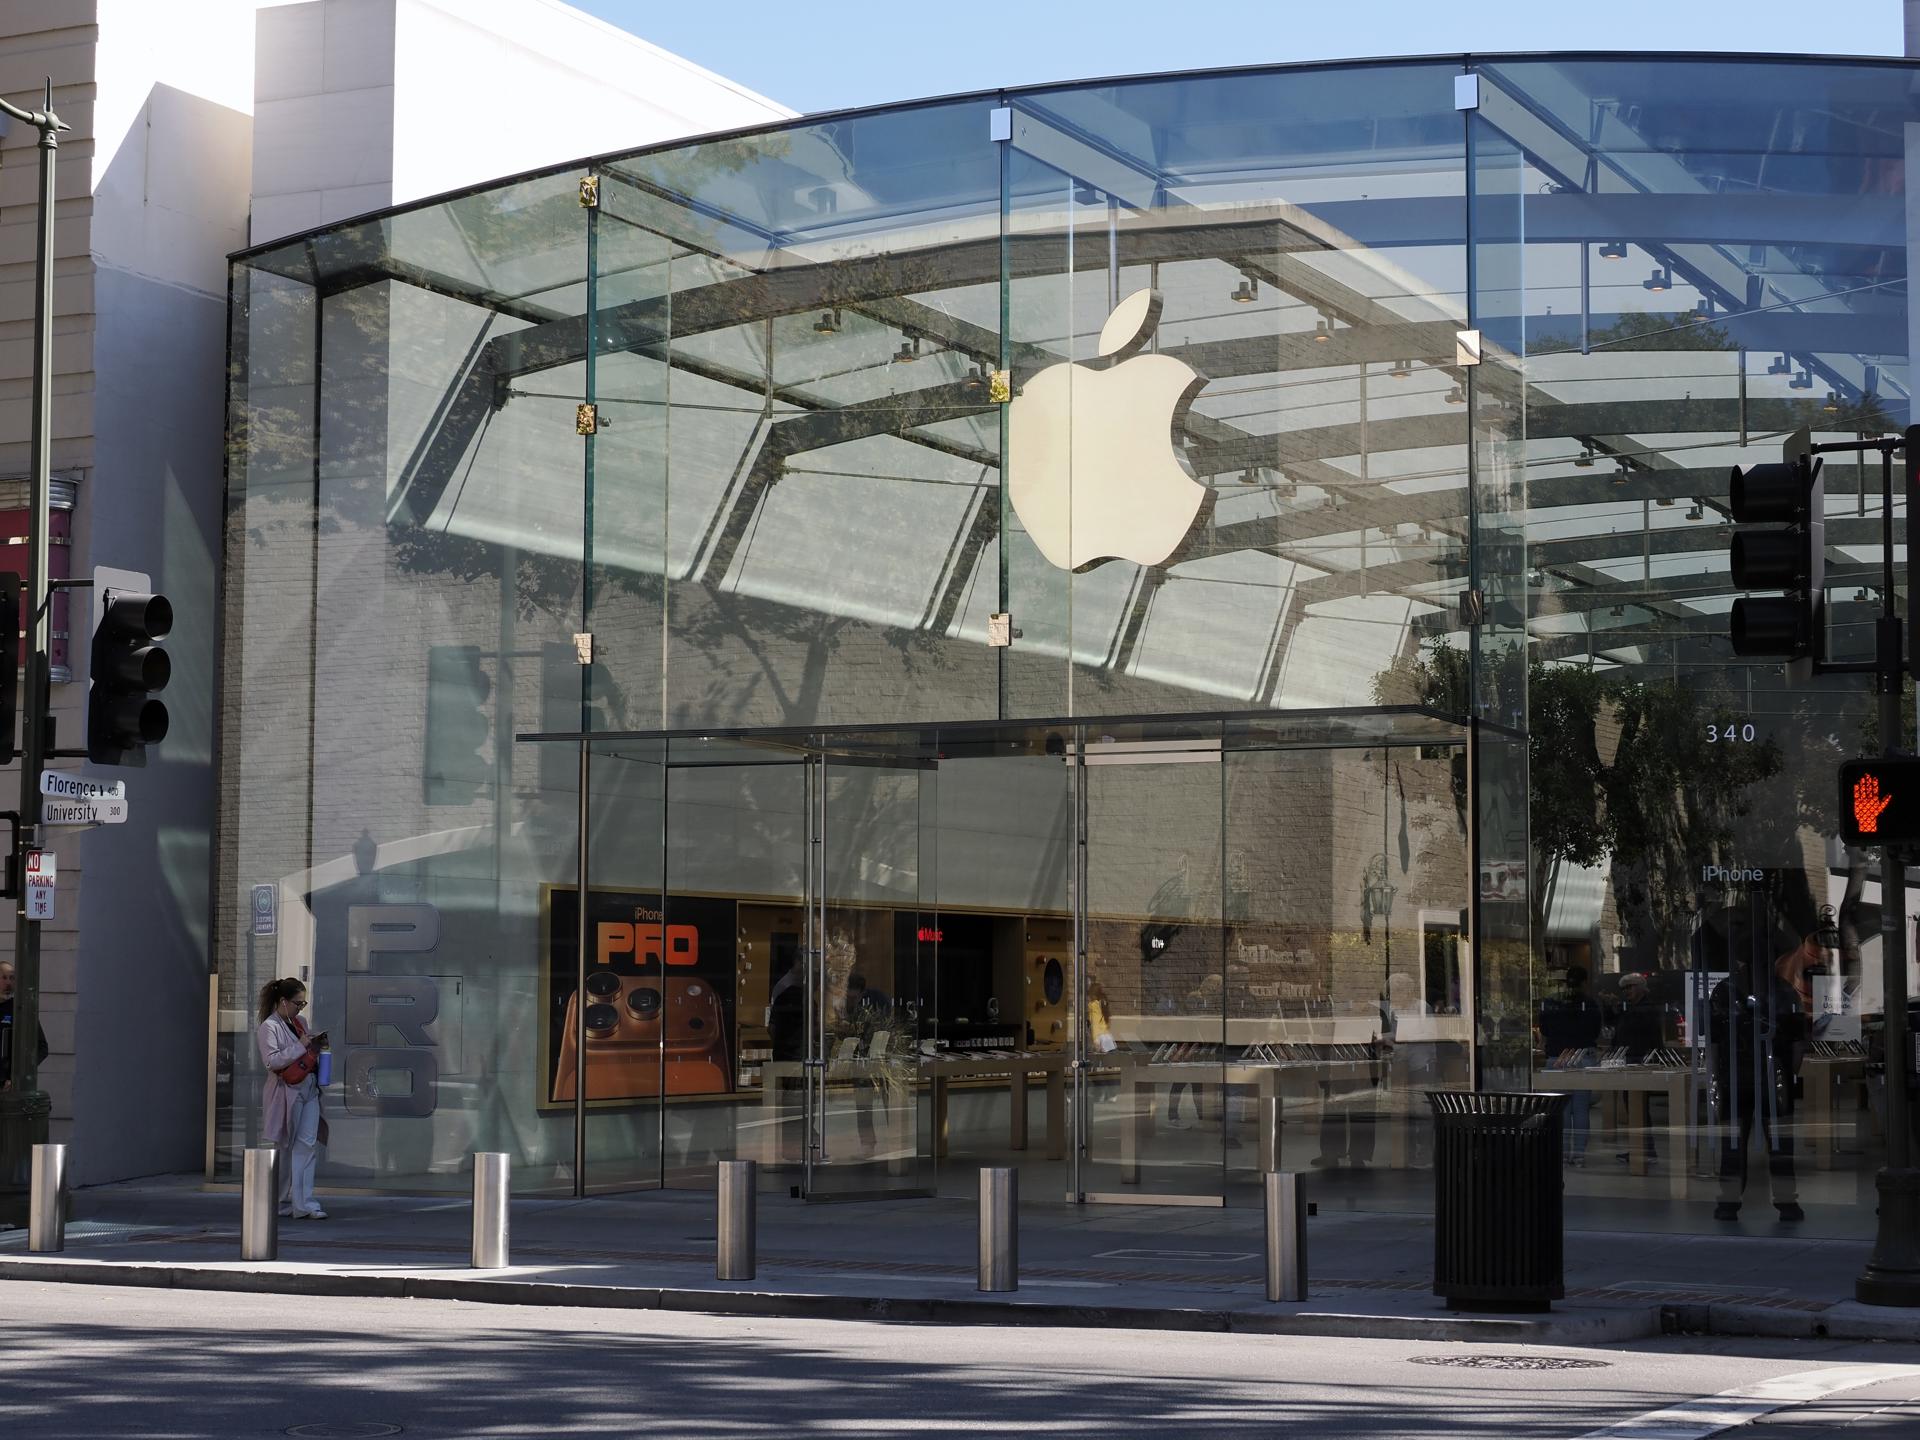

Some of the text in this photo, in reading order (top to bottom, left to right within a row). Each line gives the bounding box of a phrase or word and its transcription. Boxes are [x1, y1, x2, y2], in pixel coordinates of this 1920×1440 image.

[1705, 724, 1756, 743] 340
[47, 775, 96, 797] Florence
[47, 803, 121, 821] University 300
[28, 854, 39, 869] NO
[28, 875, 54, 888] PARKING
[1702, 865, 1764, 882] iPhone
[35, 889, 47, 899] ANY
[34, 902, 47, 912] TIME
[597, 922, 699, 966] PRO
[344, 903, 441, 1119] PRO
